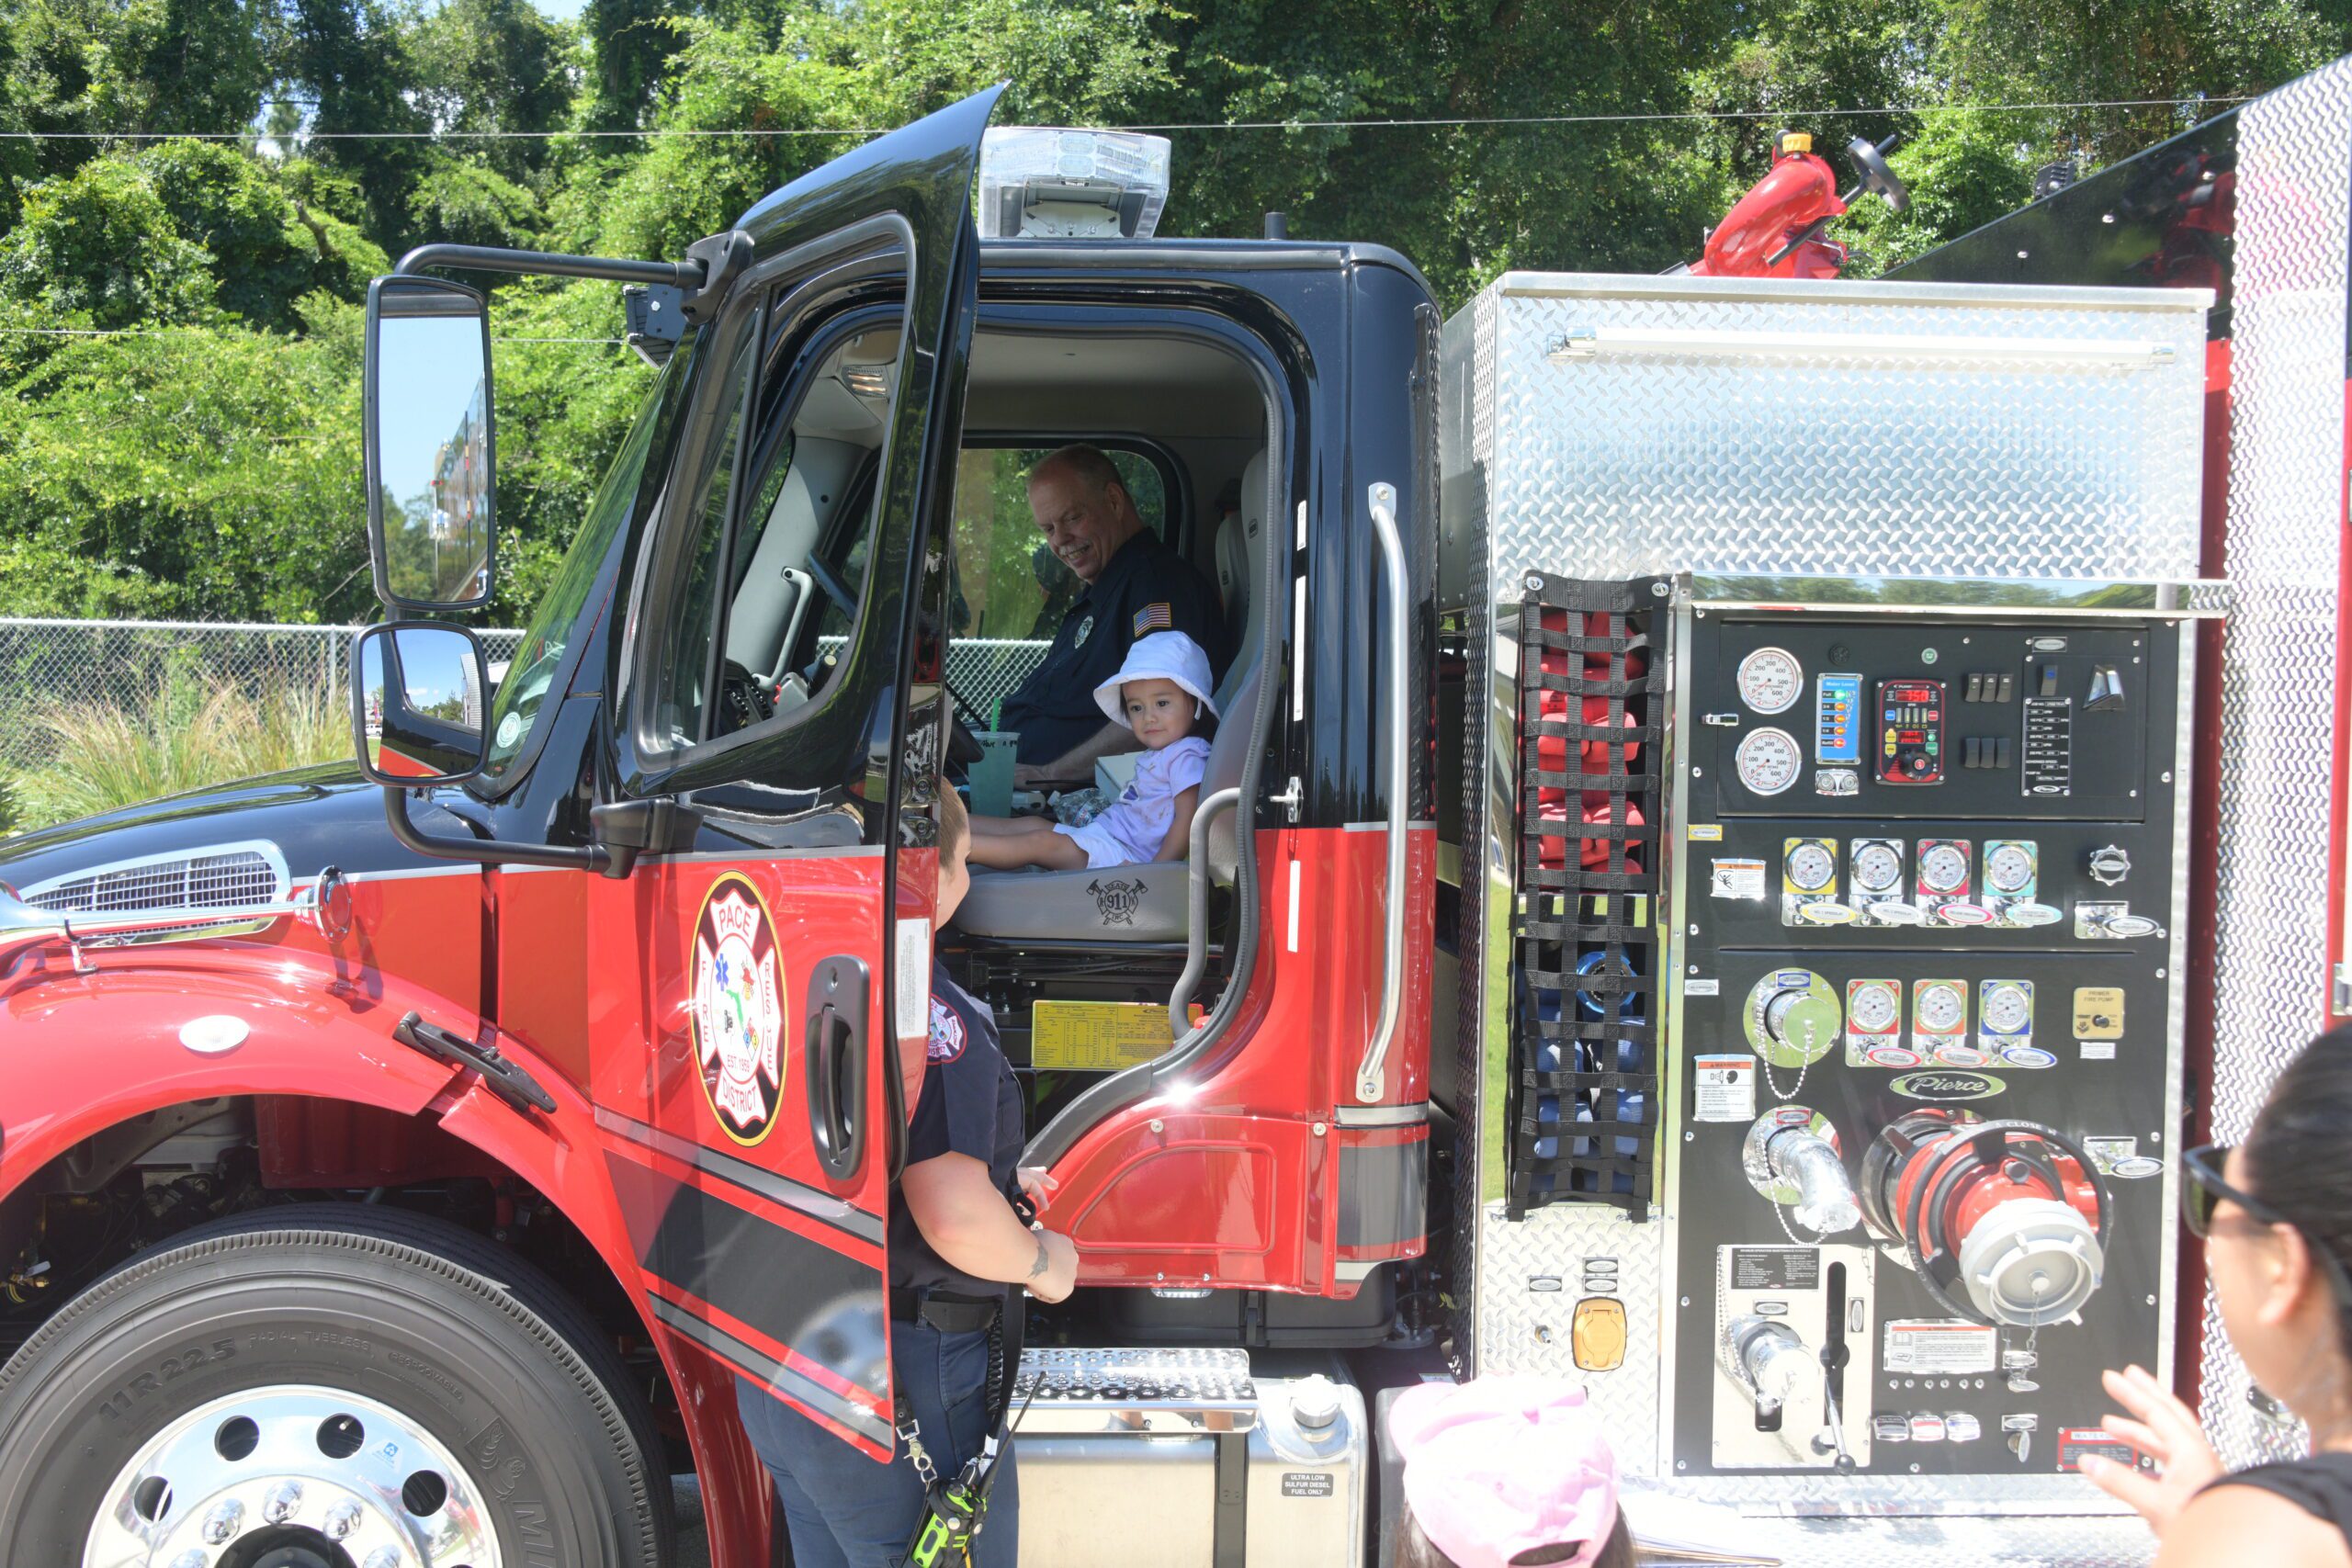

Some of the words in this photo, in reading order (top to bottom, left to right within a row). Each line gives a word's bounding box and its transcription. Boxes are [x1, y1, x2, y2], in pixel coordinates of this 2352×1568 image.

[1107, 893, 1127, 910] 911
[719, 905, 751, 937] PACE
[727, 1054, 737, 1069] EST.
[738, 1058, 750, 1073] 1959
[723, 1076, 756, 1113] DISTRICT
[1911, 1077, 1985, 1092] Pierce
[2007, 1121, 2042, 1130] CLOSE
[249, 1330, 296, 1348] RADIAL
[305, 1331, 371, 1352] TUBELESS
[389, 1352, 463, 1402] REGROOVABLE
